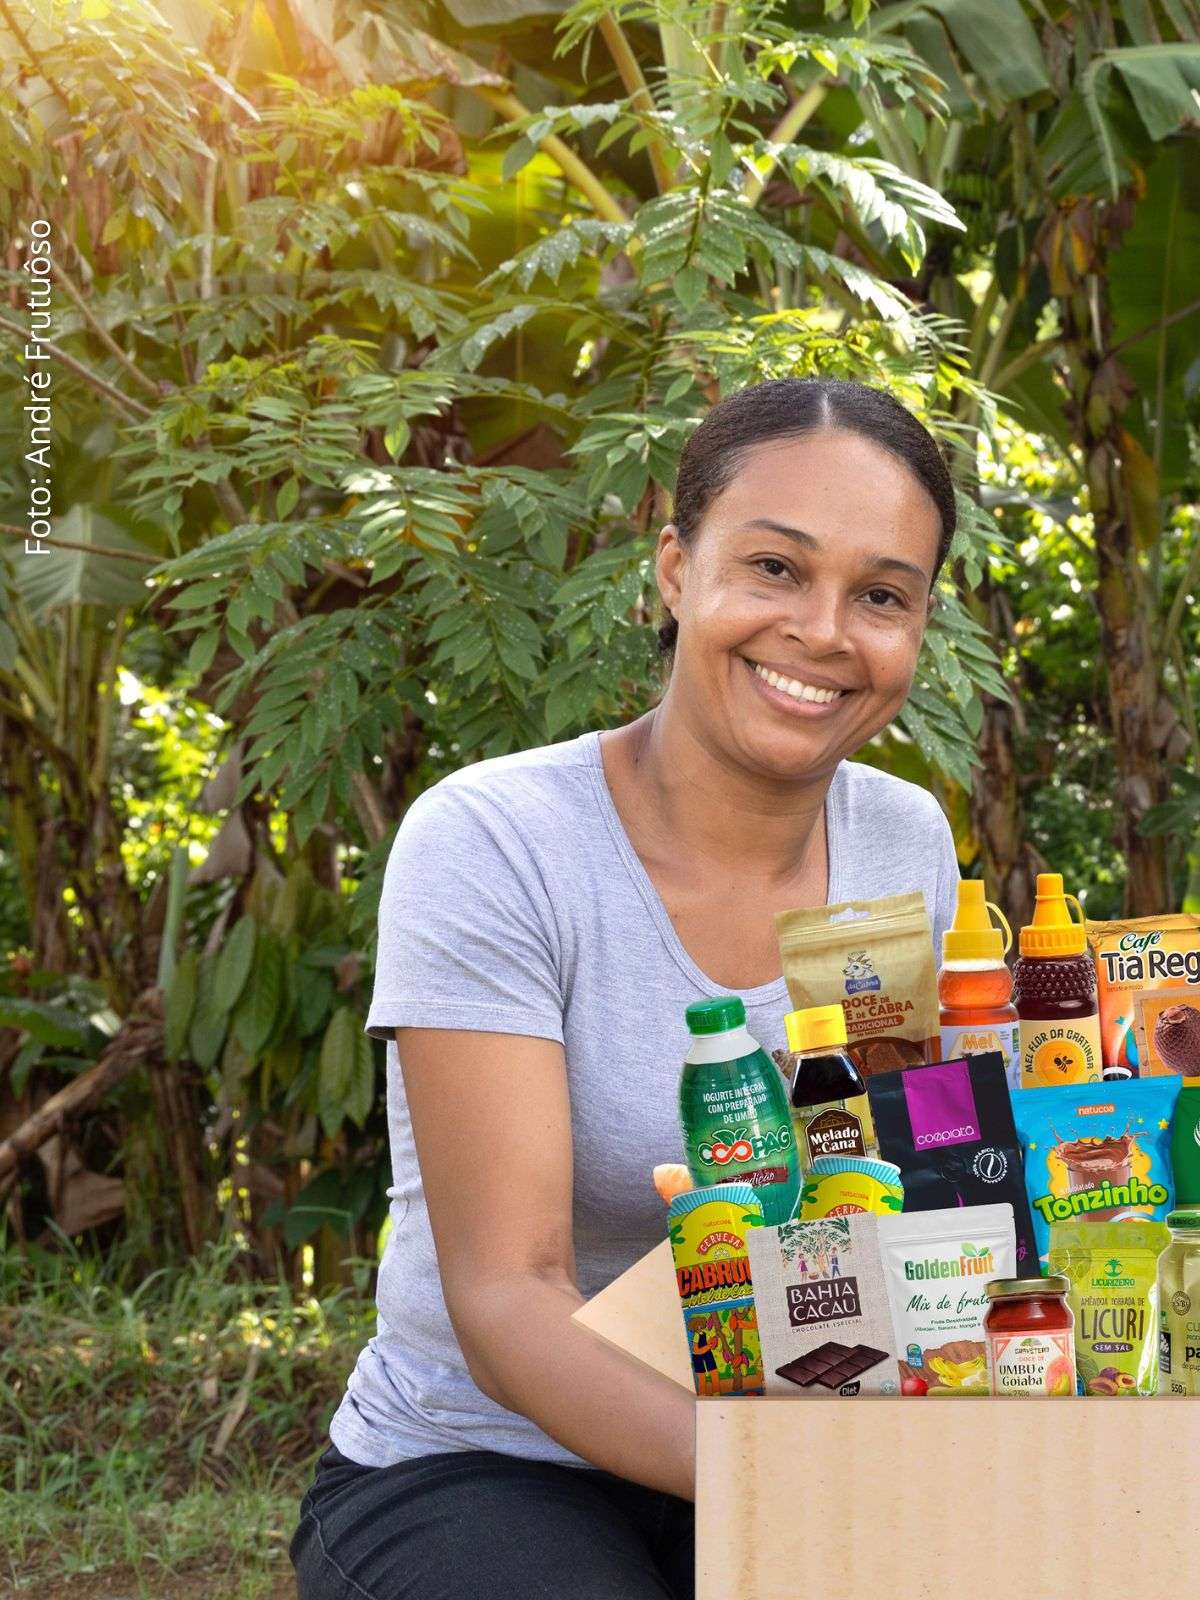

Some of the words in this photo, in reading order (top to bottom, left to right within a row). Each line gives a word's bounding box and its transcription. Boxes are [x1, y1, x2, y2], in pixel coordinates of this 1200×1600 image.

[1120, 930, 1164, 952] Café
[1100, 952, 1144, 982] Tia
[841, 995, 876, 1009] DOCE
[869, 1000, 914, 1017] CABRA
[848, 1018, 899, 1032] RADICIONAL
[963, 1034, 994, 1050] Mel
[1028, 1032, 1048, 1052] FLOR
[1025, 1054, 1034, 1073] MEL
[704, 1090, 734, 1102] IOGURTE
[708, 1102, 724, 1114] COM
[725, 1094, 768, 1112] PREPARADO
[723, 1114, 734, 1124] DE
[1078, 1105, 1114, 1115] natucoa
[810, 1126, 859, 1146] Melado
[821, 1139, 856, 1153] Cana
[1034, 1178, 1168, 1223] Tonzinho
[700, 1232, 741, 1252] CERVEJA
[905, 1253, 994, 1280] GoldenFruit
[677, 1256, 752, 1297] CABRU
[790, 1282, 854, 1304] BAHIA
[794, 1298, 856, 1320] CACAU
[906, 1294, 930, 1312] Mix
[936, 1294, 951, 1310] de
[1081, 1308, 1144, 1340] LICURI
[1000, 1364, 1035, 1375] UMBU
[1002, 1375, 1042, 1386] Goiaba
[842, 1386, 858, 1395] Diet
